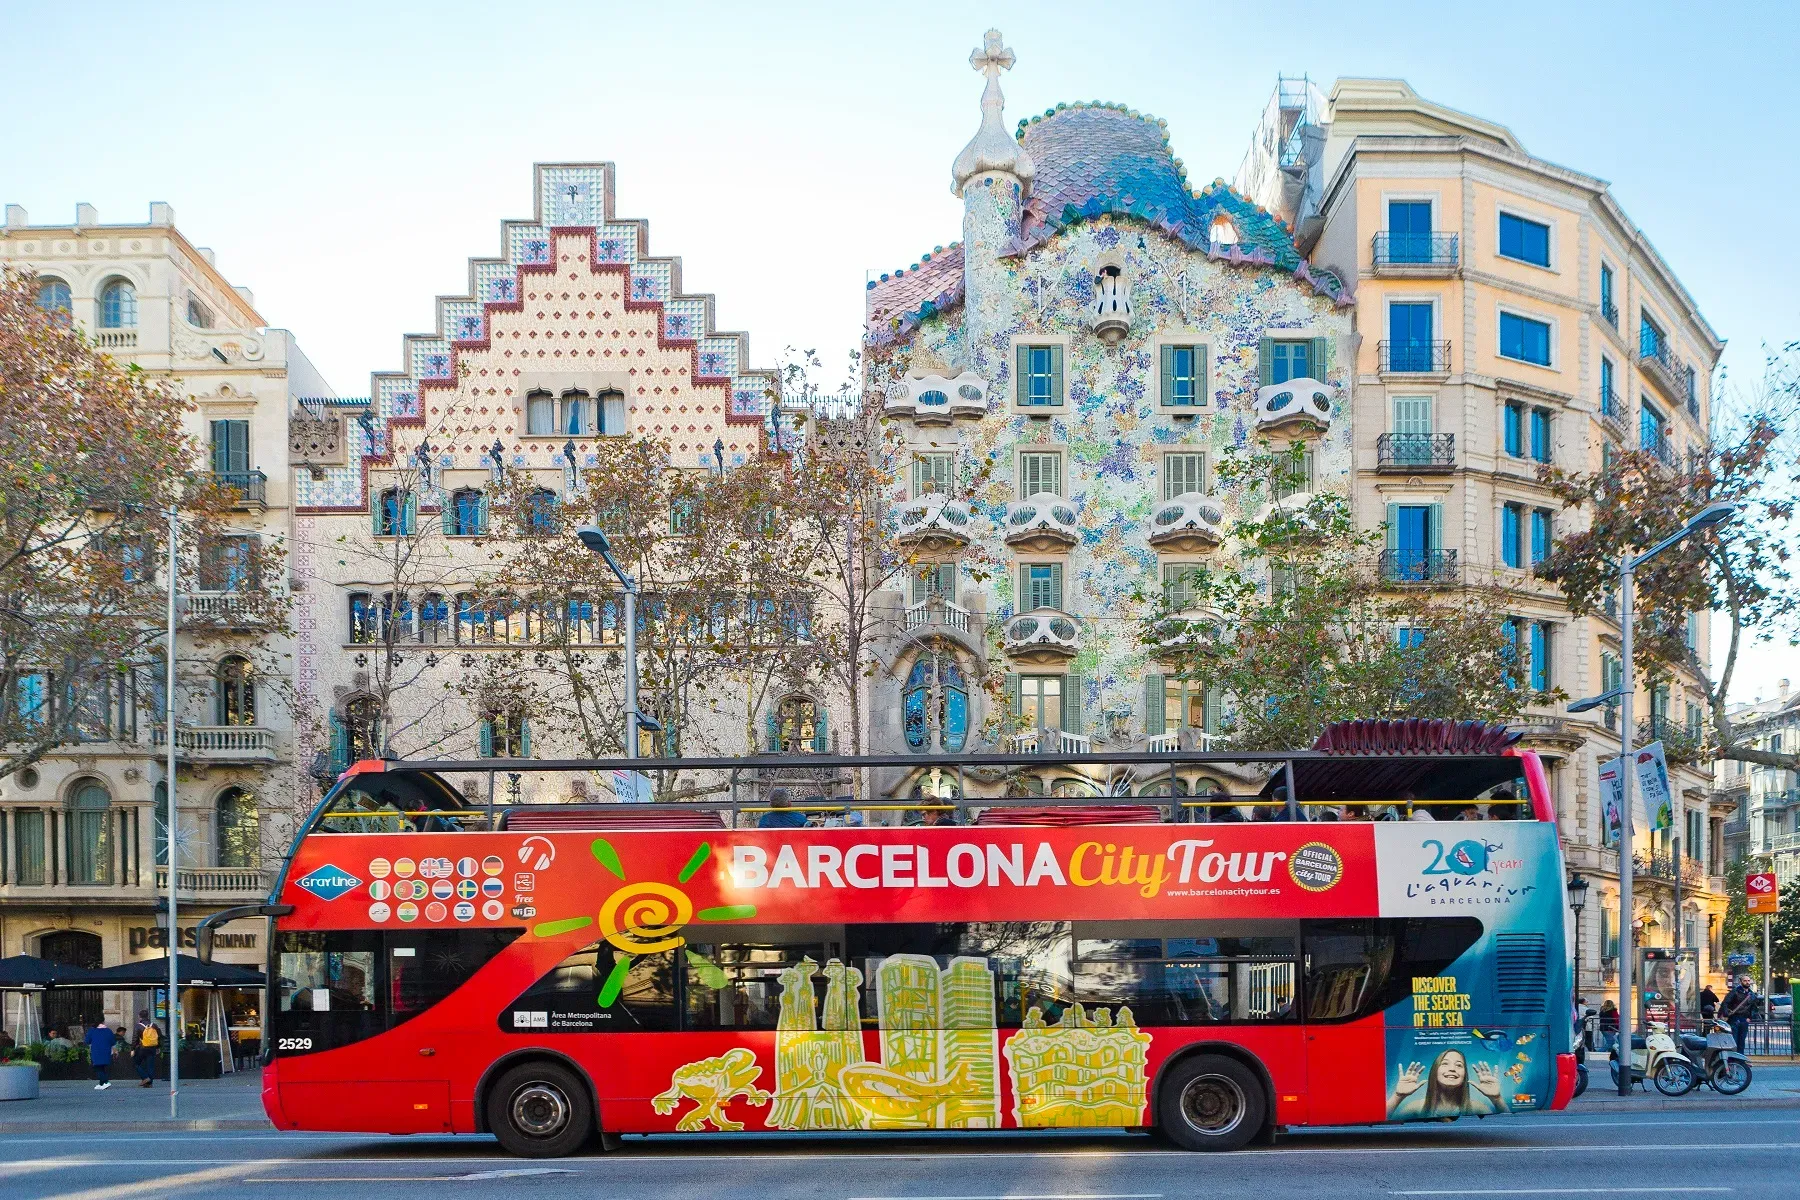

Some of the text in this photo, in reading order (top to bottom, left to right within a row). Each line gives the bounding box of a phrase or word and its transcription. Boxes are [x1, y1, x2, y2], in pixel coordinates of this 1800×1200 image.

[1302, 849, 1333, 862] OFFICIAL
[732, 839, 1287, 899] BARCELONA City Tour
[1295, 858, 1338, 873] BARCELONA
[1492, 859, 1523, 875] years
[1295, 870, 1332, 882] city TOUR
[515, 894, 534, 903] Free
[1167, 887, 1281, 898] www.barcelonacitytour.es
[1430, 897, 1511, 905] BARCELONA
[214, 933, 257, 949] COMPANY
[1412, 977, 1456, 993] DISCOVER
[1413, 994, 1470, 1010] THE SECRETS
[551, 1011, 612, 1020] Àrea Metropolitana
[1414, 1012, 1463, 1027] OF THE SEA
[278, 1037, 313, 1050] 2529
